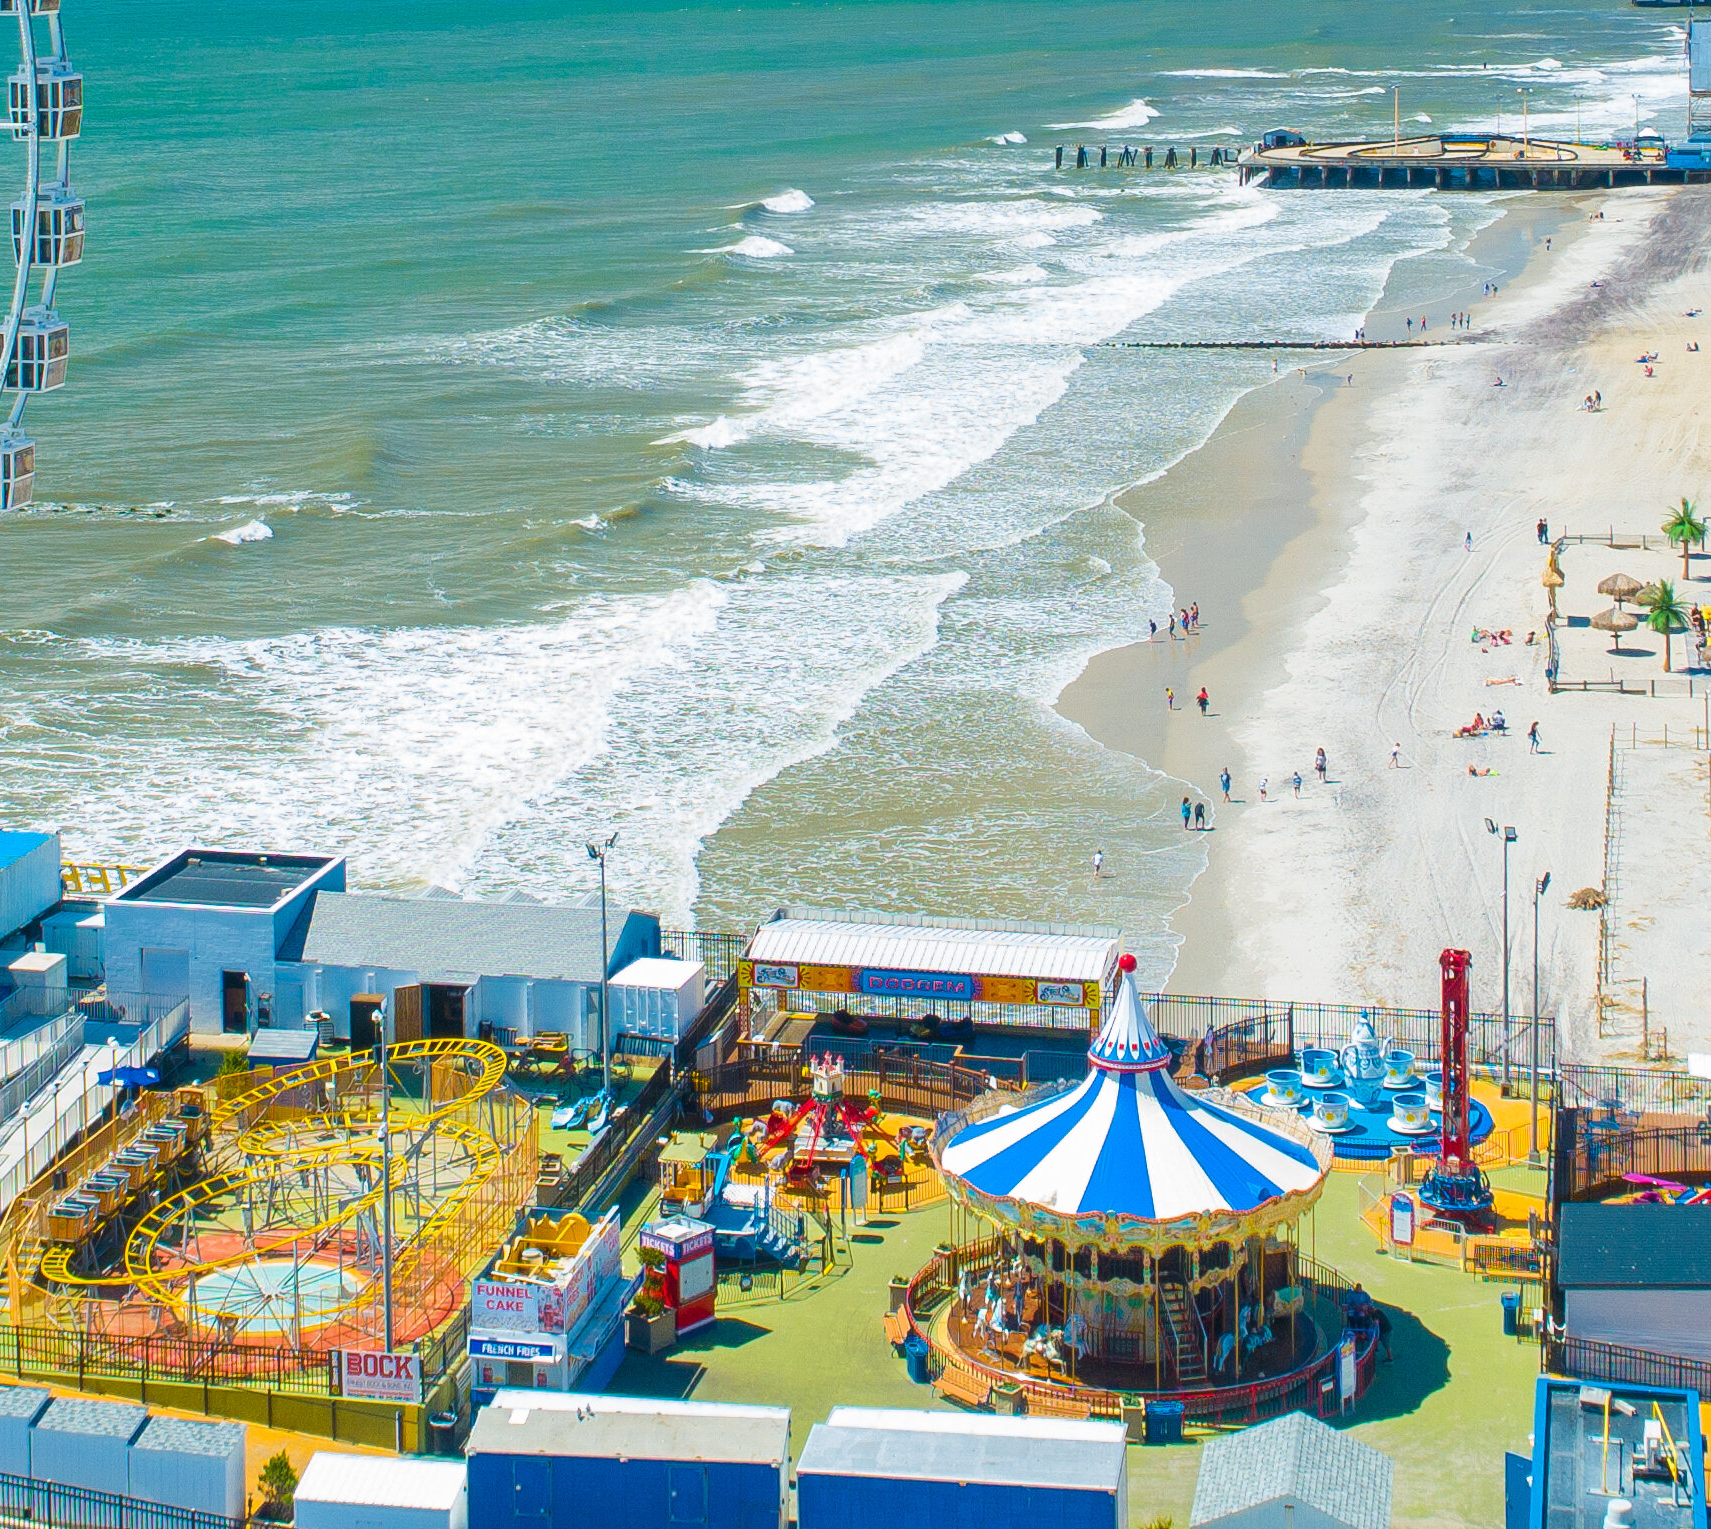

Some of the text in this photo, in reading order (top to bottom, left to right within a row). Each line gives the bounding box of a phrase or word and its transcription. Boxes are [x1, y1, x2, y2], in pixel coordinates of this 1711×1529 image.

[868, 975, 966, 993] DODGEM
[641, 1233, 676, 1256] TICKETS
[682, 1232, 713, 1255] TICKETS
[476, 1284, 533, 1300] FUNNEL
[486, 1299, 524, 1312] CAKE
[481, 1342, 541, 1357] FRENCH FRIES
[346, 1352, 414, 1379] BOCK
